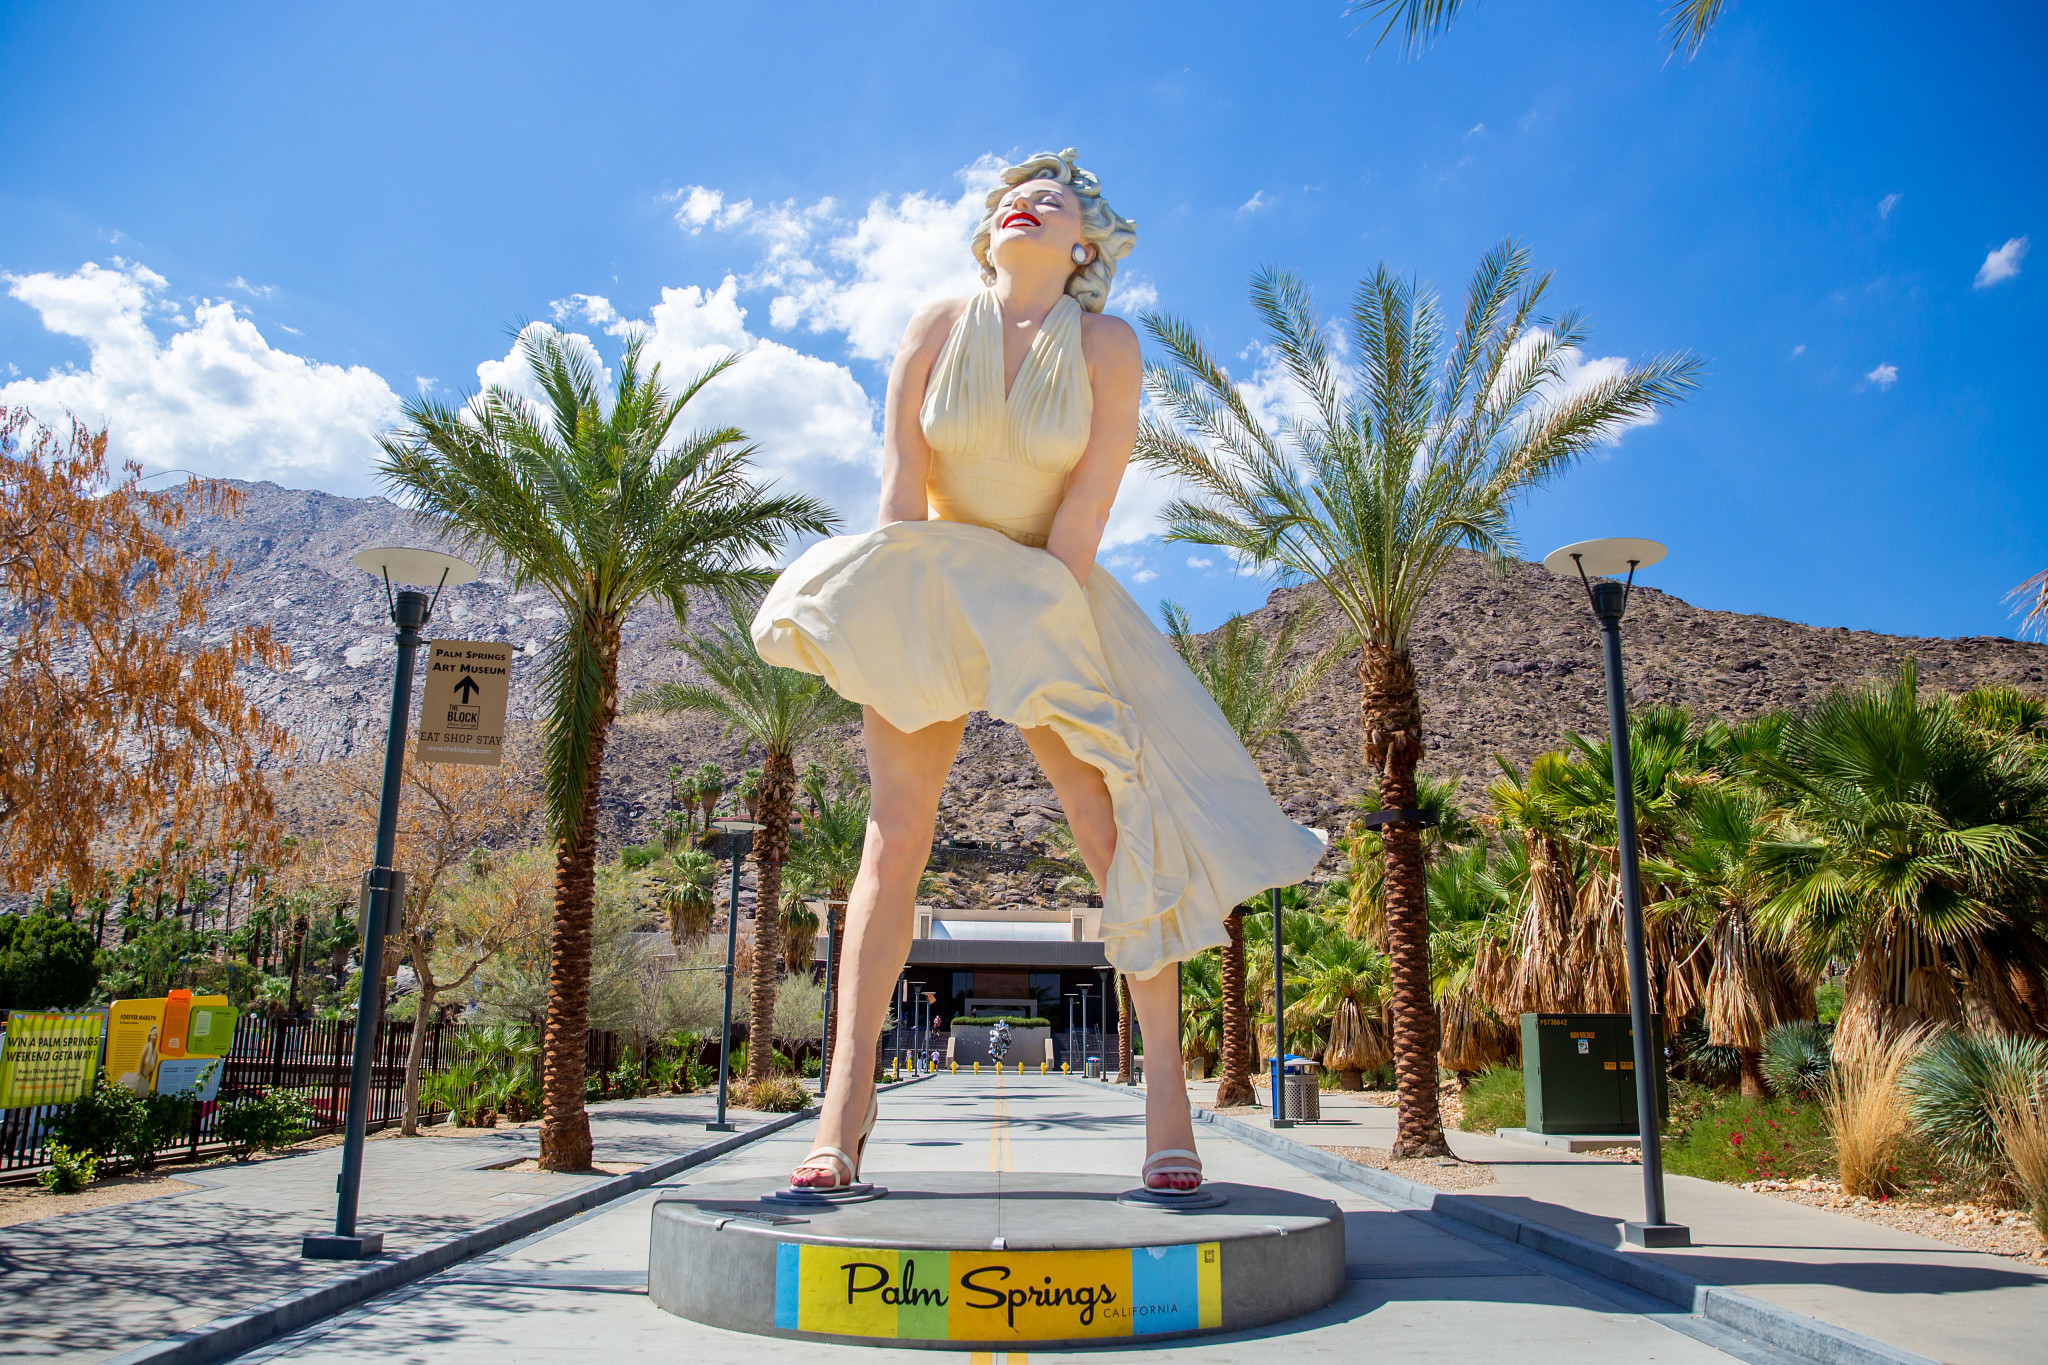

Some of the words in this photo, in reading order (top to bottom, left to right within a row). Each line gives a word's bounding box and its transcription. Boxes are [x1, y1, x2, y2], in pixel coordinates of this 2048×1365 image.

[436, 649, 462, 658] PALM
[466, 651, 506, 661] SPRINGS
[432, 662, 456, 672] ART
[460, 664, 506, 675] MUSEUM
[447, 711, 478, 723] BLOCK
[420, 732, 441, 742] EAT
[443, 734, 473, 744] SHOP
[476, 735, 503, 746] STAY
[1580, 1031, 1596, 1039] VOLTAGE
[7, 1037, 27, 1047] WIN
[28, 1037, 36, 1047] A
[38, 1037, 60, 1047] PALM
[62, 1036, 99, 1047] SPRINGS
[6, 1051, 50, 1062] WEEKEND
[52, 1050, 96, 1061] GETAWAY!
[840, 1259, 948, 1307] Palm
[961, 1265, 1117, 1327] Springs
[1103, 1303, 1178, 1318] CALIFORNIA
